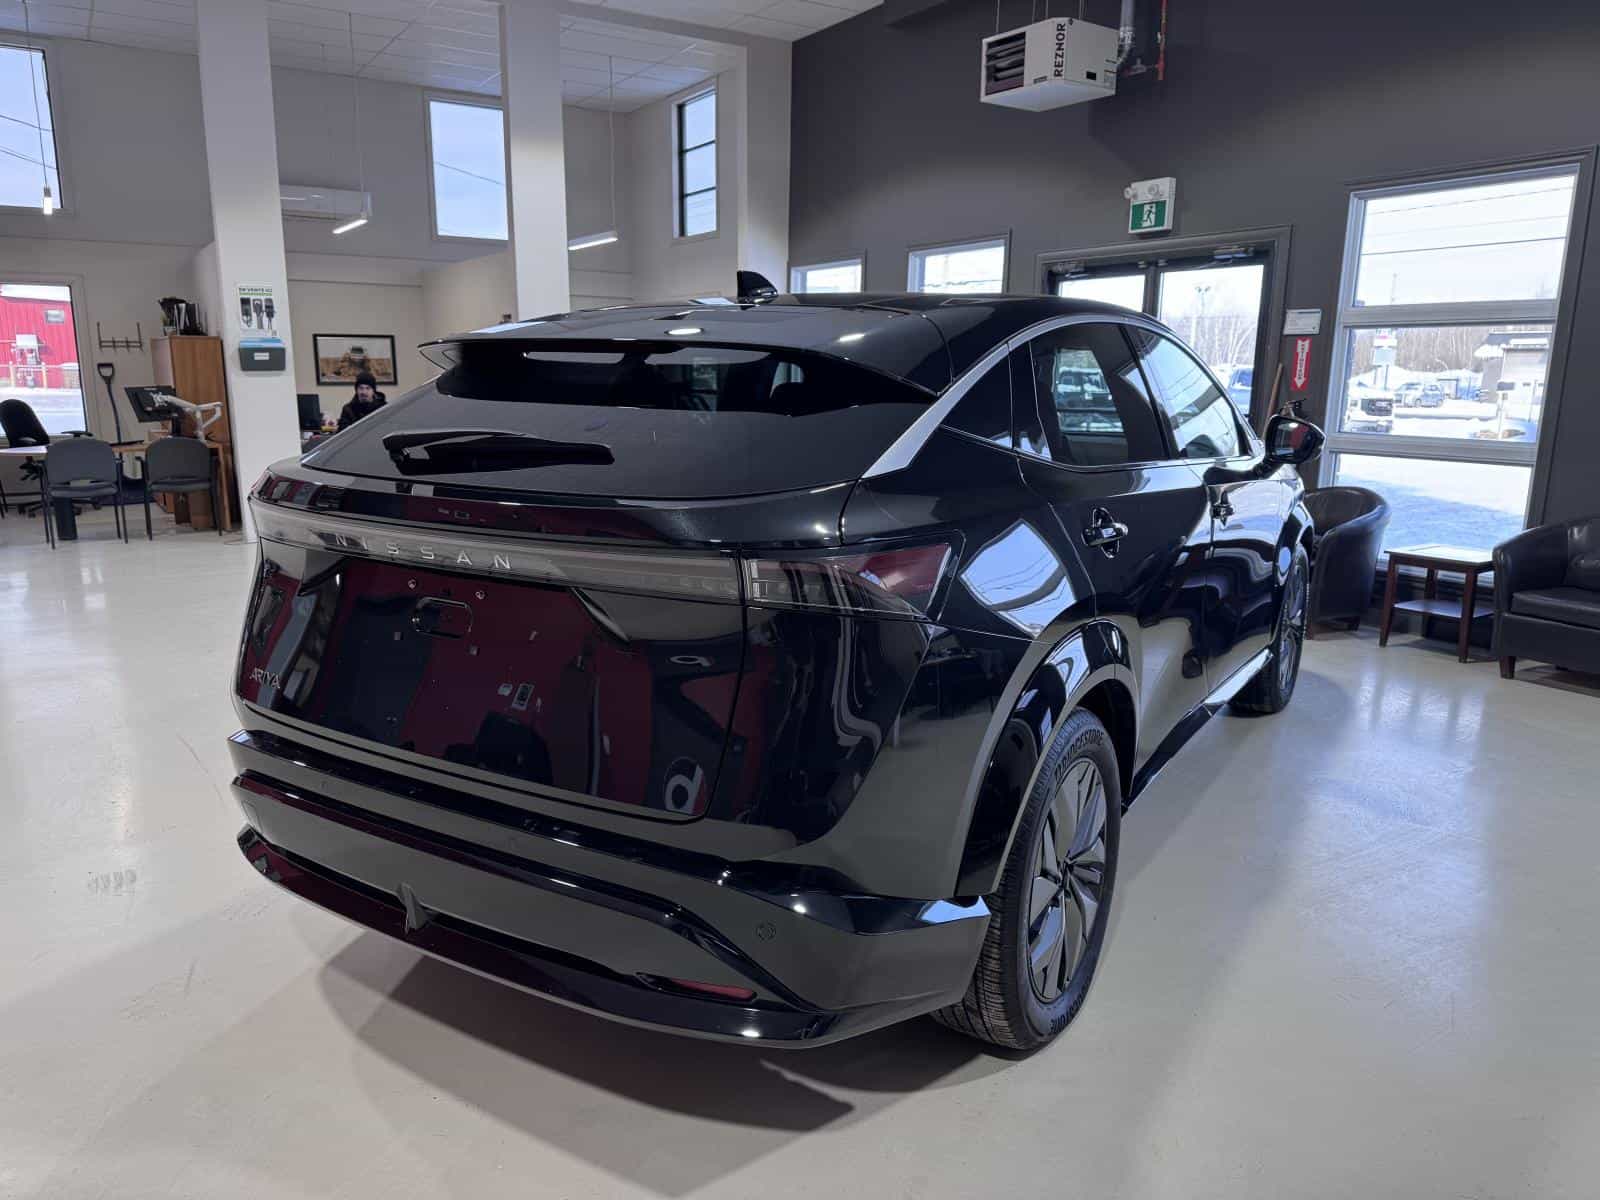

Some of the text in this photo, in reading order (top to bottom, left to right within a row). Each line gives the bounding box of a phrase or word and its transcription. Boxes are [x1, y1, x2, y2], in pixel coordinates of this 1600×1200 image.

[1054, 23, 1066, 77] REZNOR
[335, 532, 511, 570] NISSAN
[249, 667, 281, 689] ARIYA
